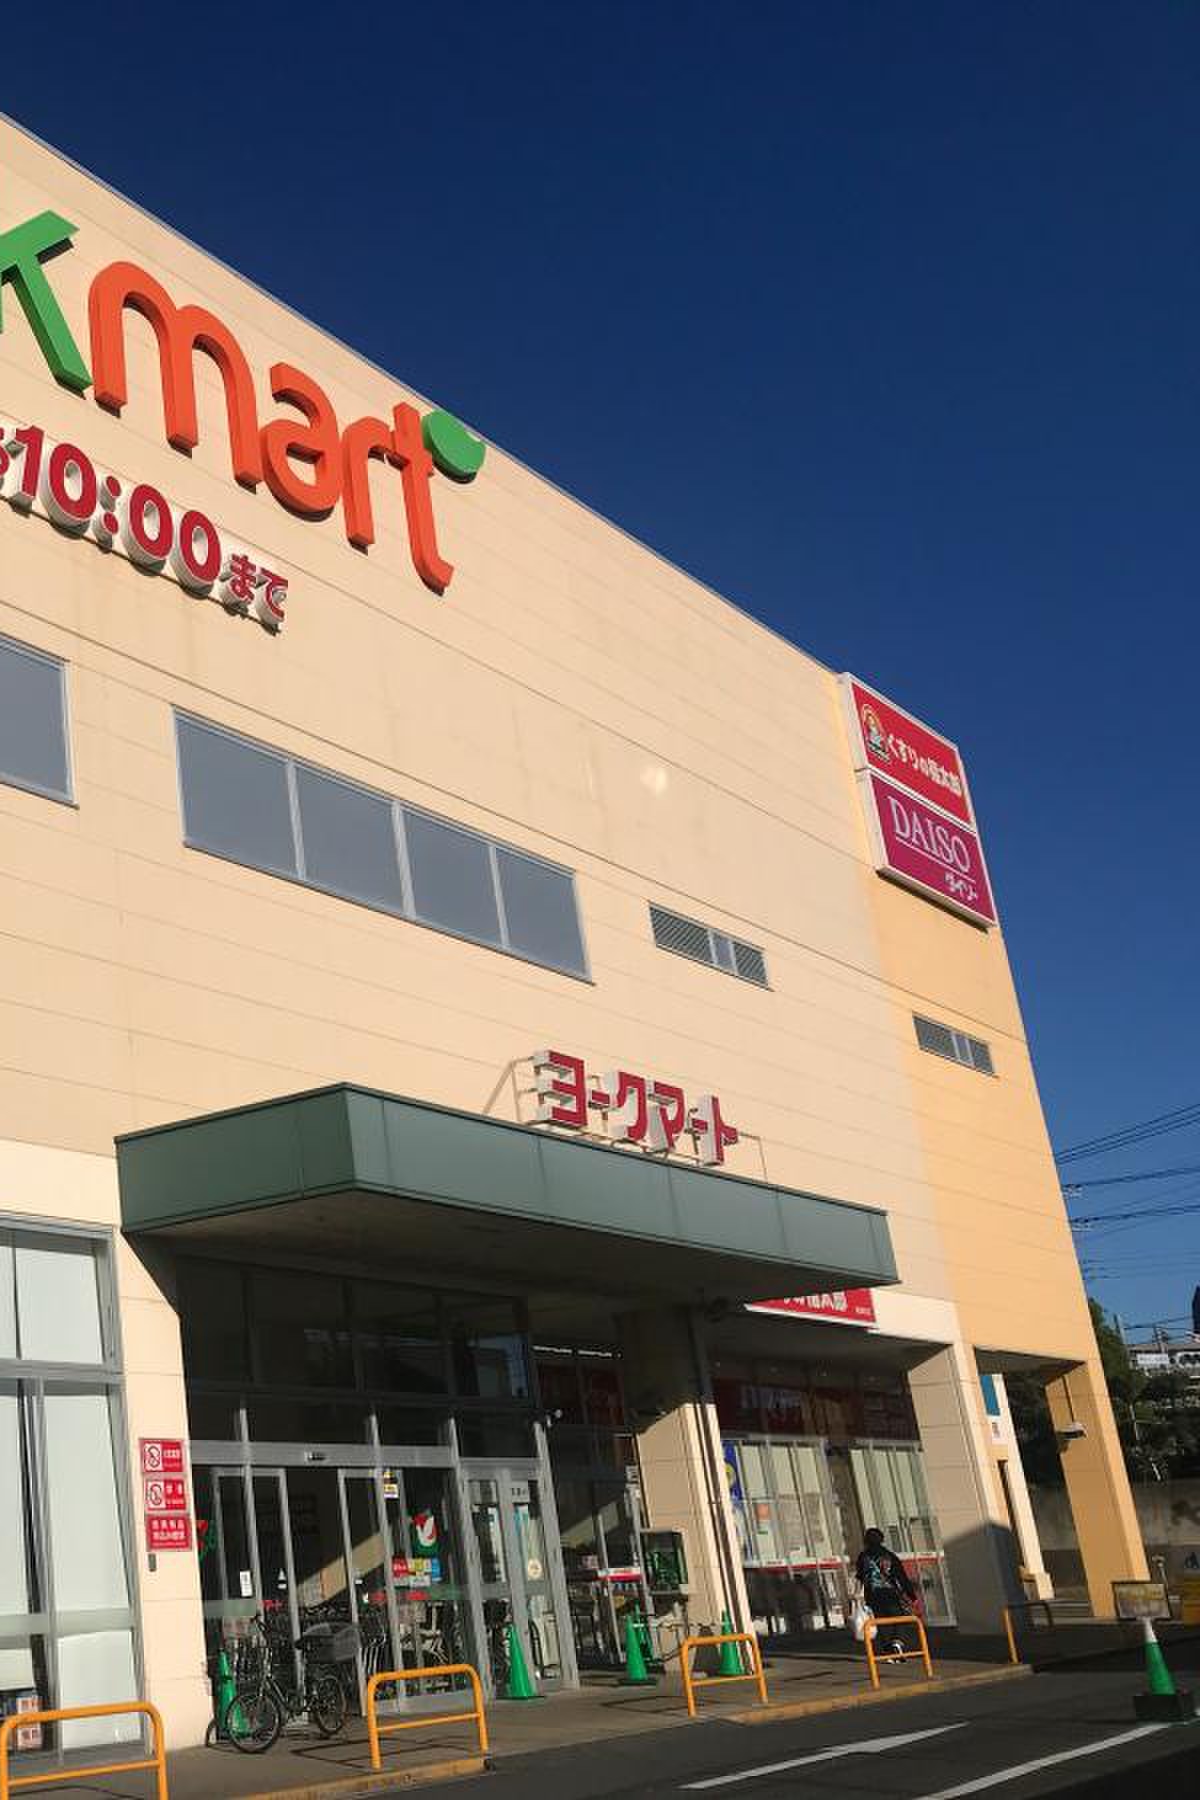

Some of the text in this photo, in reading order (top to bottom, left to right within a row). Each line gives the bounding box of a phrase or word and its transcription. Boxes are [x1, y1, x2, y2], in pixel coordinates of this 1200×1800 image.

[887, 795, 971, 873] DAISO
[540, 1049, 739, 1166] ヨークマート
